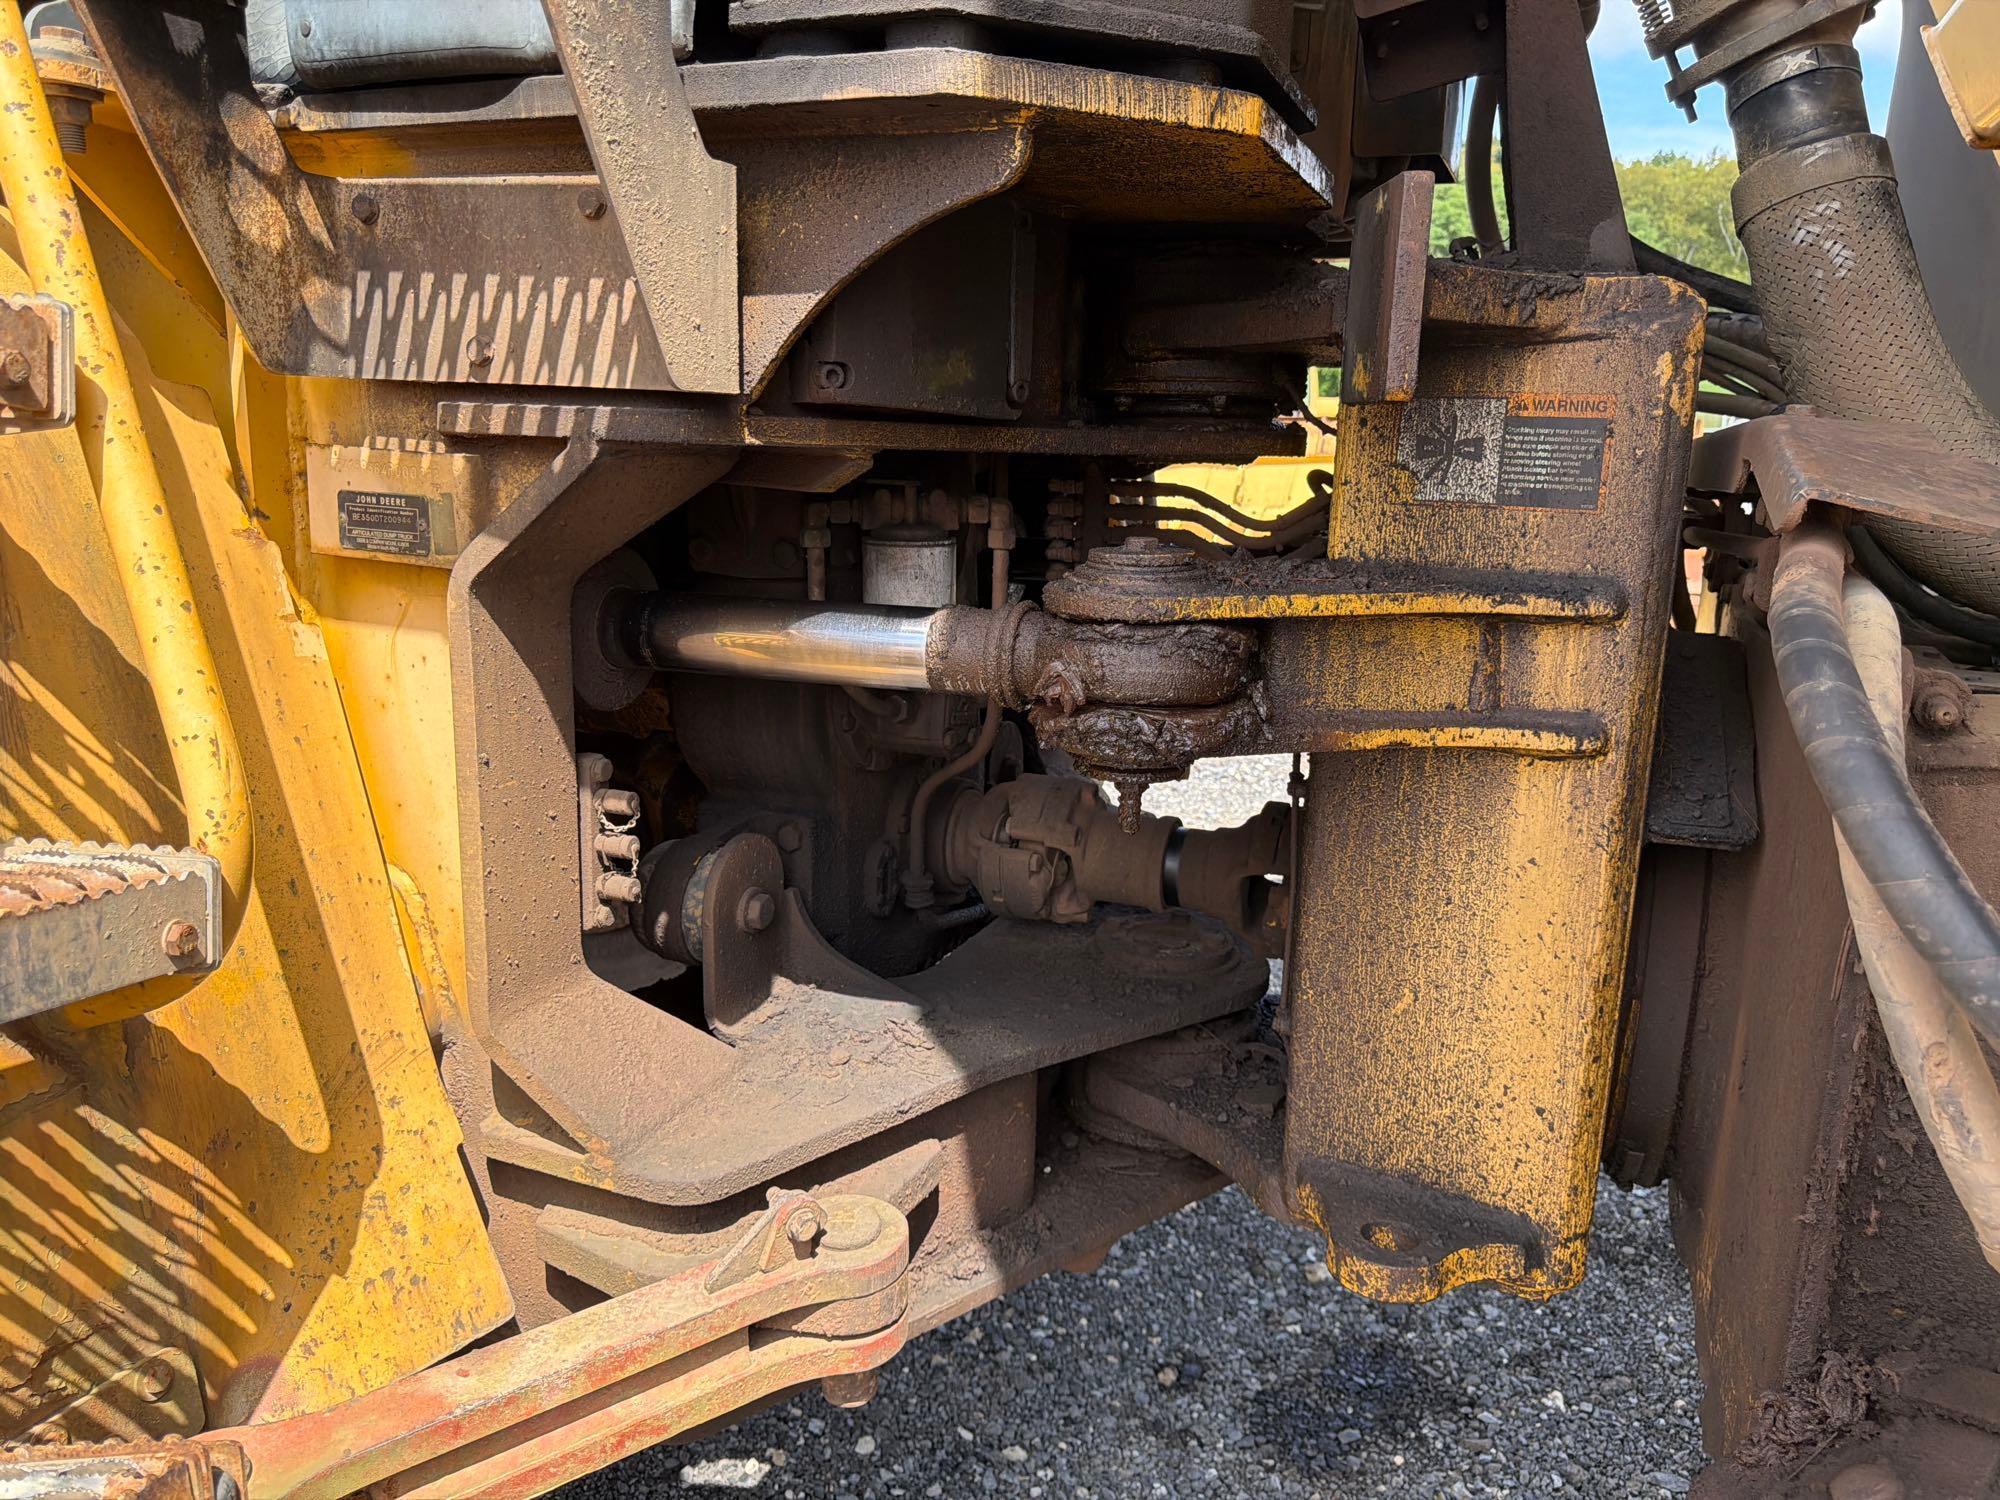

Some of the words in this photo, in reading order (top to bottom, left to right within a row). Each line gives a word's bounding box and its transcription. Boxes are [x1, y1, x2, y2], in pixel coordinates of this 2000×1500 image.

[1533, 400, 1608, 412] WARNING
[356, 495, 376, 504] JOHN
[380, 496, 406, 506] DEERE
[352, 529, 382, 538] ARTICULATED
